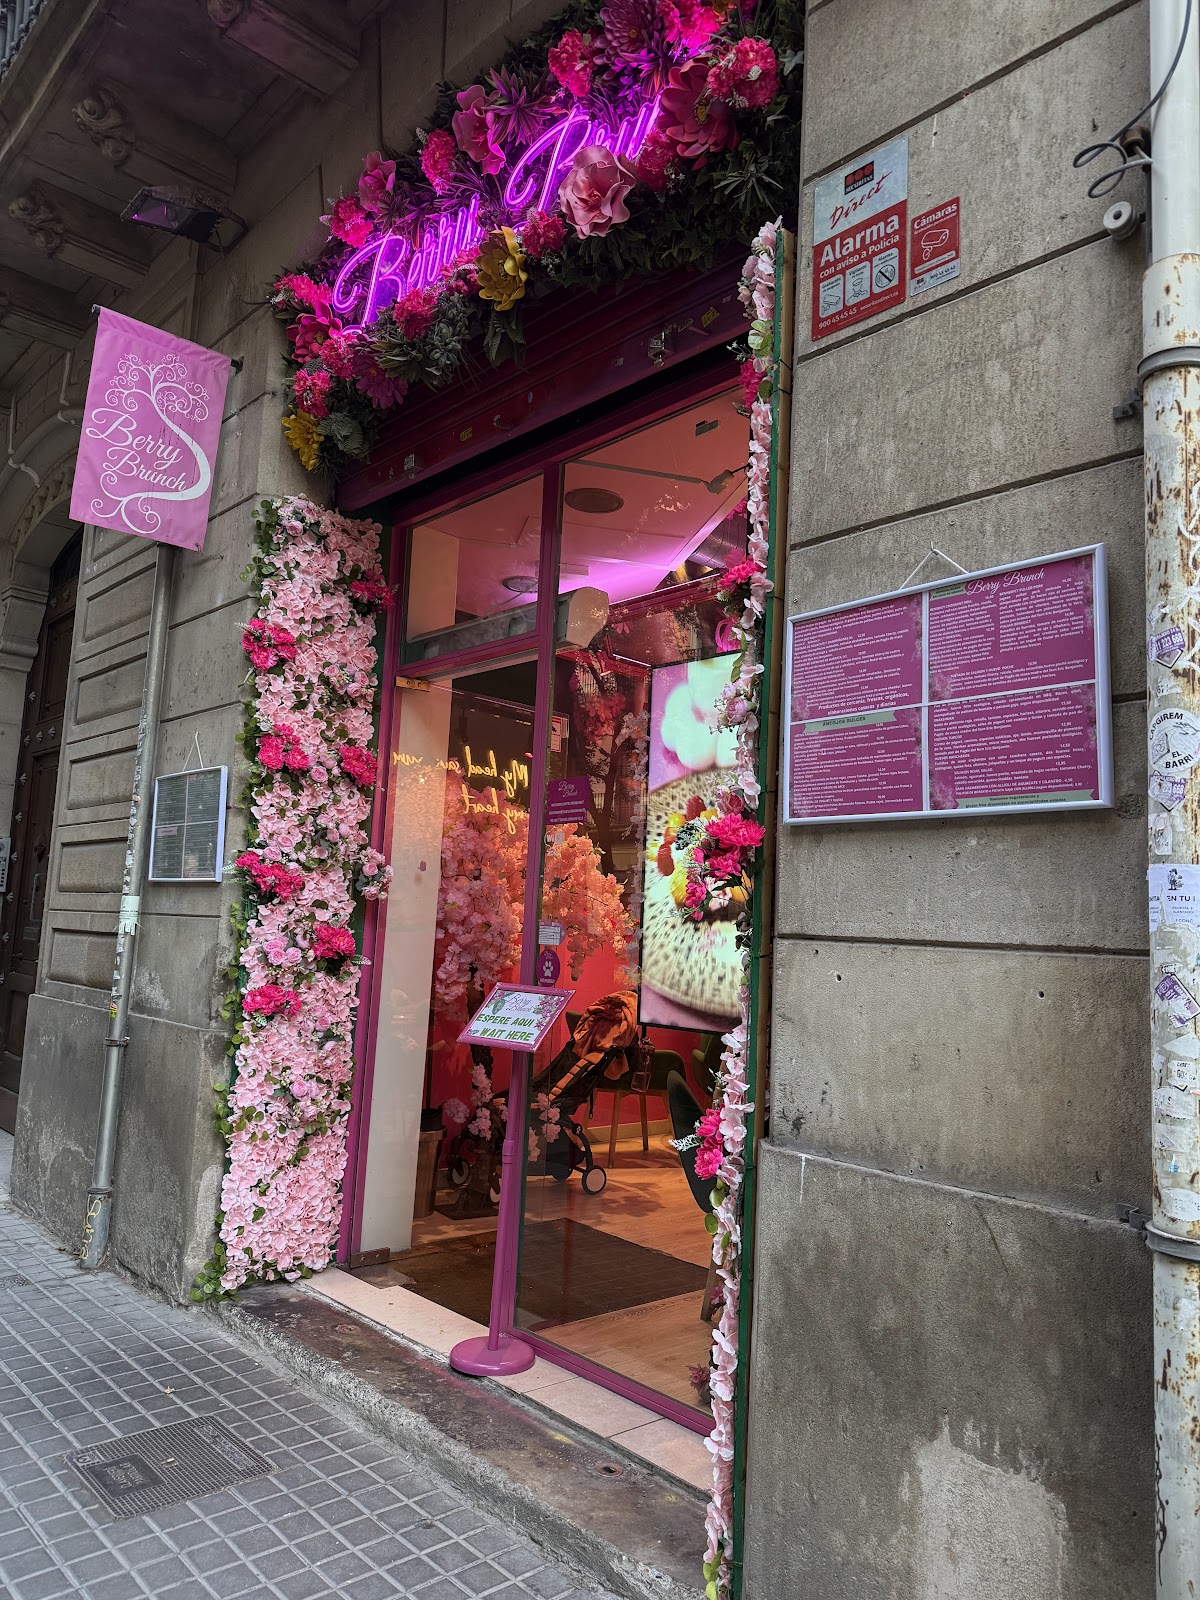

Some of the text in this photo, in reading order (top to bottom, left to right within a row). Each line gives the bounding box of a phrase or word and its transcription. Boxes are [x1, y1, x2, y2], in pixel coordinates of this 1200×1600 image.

[829, 171, 892, 230] Direct
[914, 203, 958, 229] Cámaras
[820, 214, 899, 268] Alarma
[820, 267, 834, 278] con
[836, 255, 859, 270] aviso
[869, 234, 899, 254] Policía
[819, 319, 831, 329] 900
[86, 408, 184, 470] Berry
[103, 447, 186, 492] Brunch
[967, 580, 1001, 595] Berry
[1003, 568, 1044, 587] Brunch
[1149, 712, 1184, 740] CAPGIREM
[1165, 754, 1195, 769] BARRI
[1172, 750, 1182, 758] EL
[477, 1014, 535, 1026] ESPERE AQUI
[480, 1028, 534, 1041] WAIT HERE
